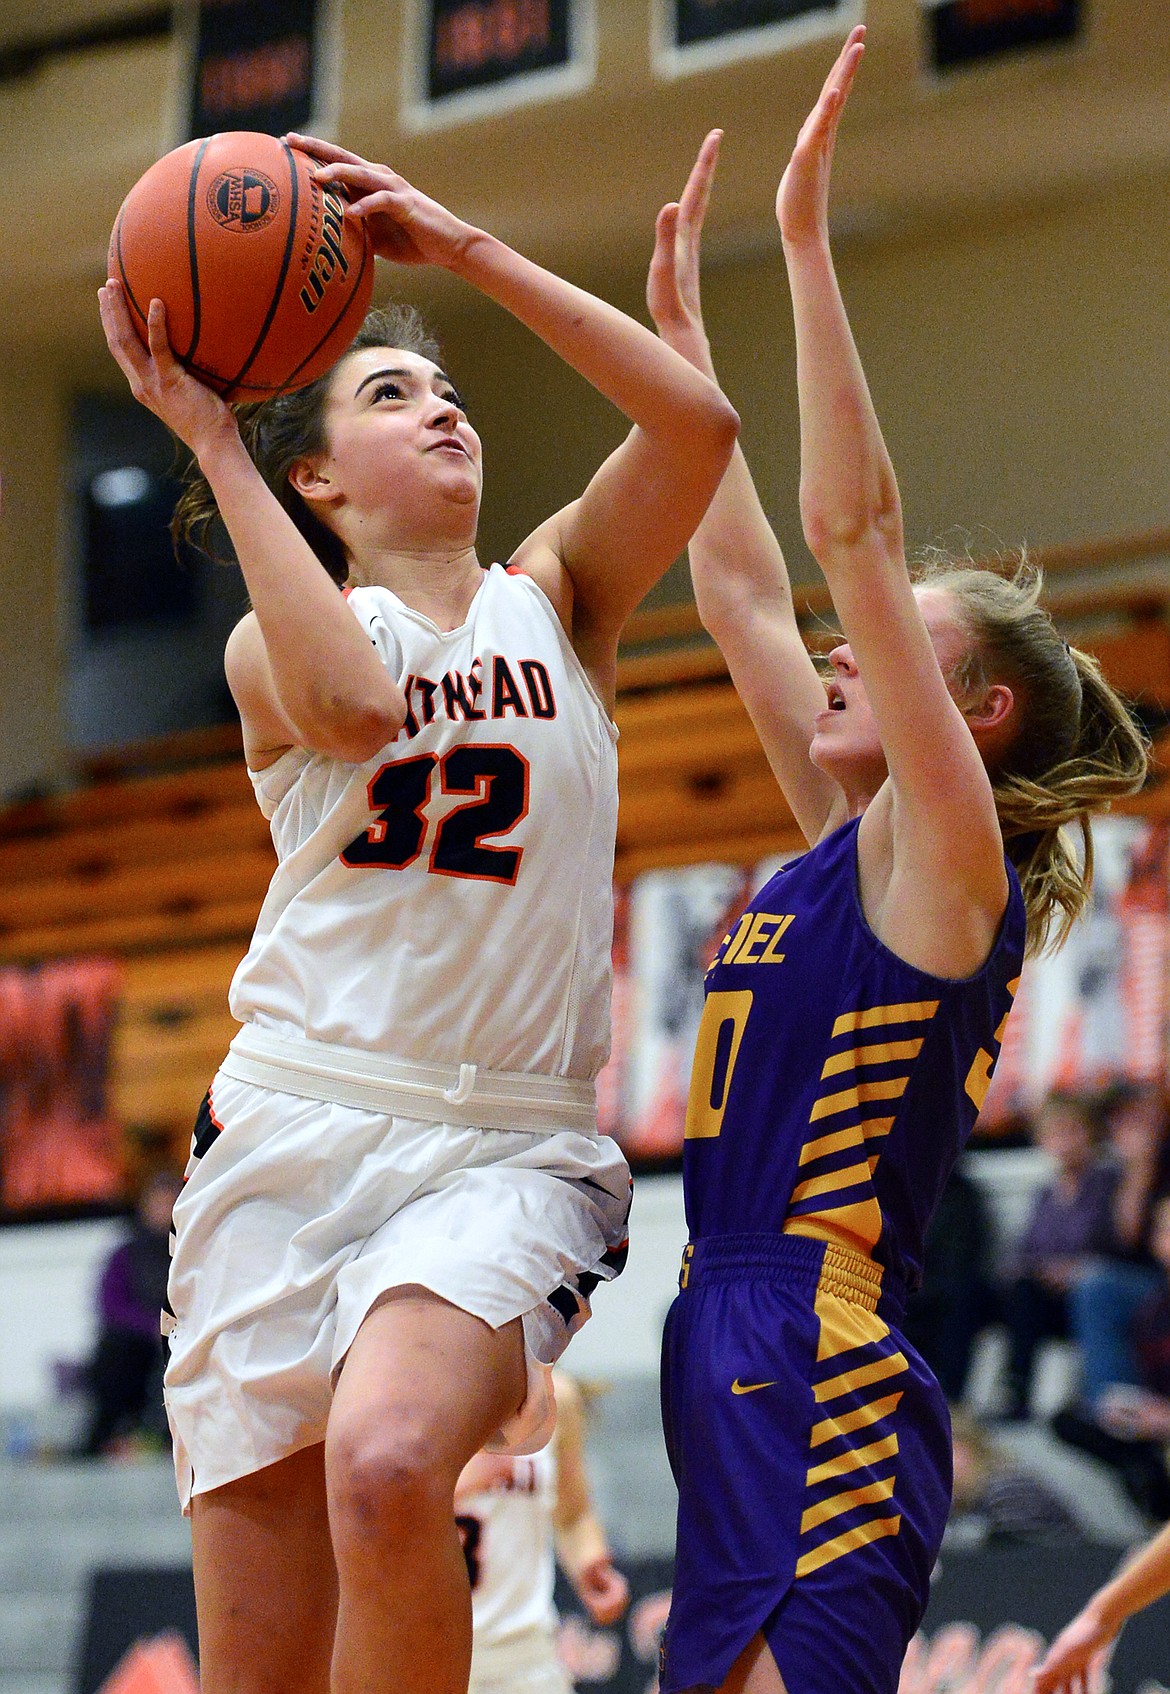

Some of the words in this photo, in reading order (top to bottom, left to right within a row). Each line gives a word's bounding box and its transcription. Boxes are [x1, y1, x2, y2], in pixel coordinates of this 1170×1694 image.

[224, 175, 242, 222] MHSA
[299, 180, 350, 314] aden
[339, 742, 530, 886] 32
